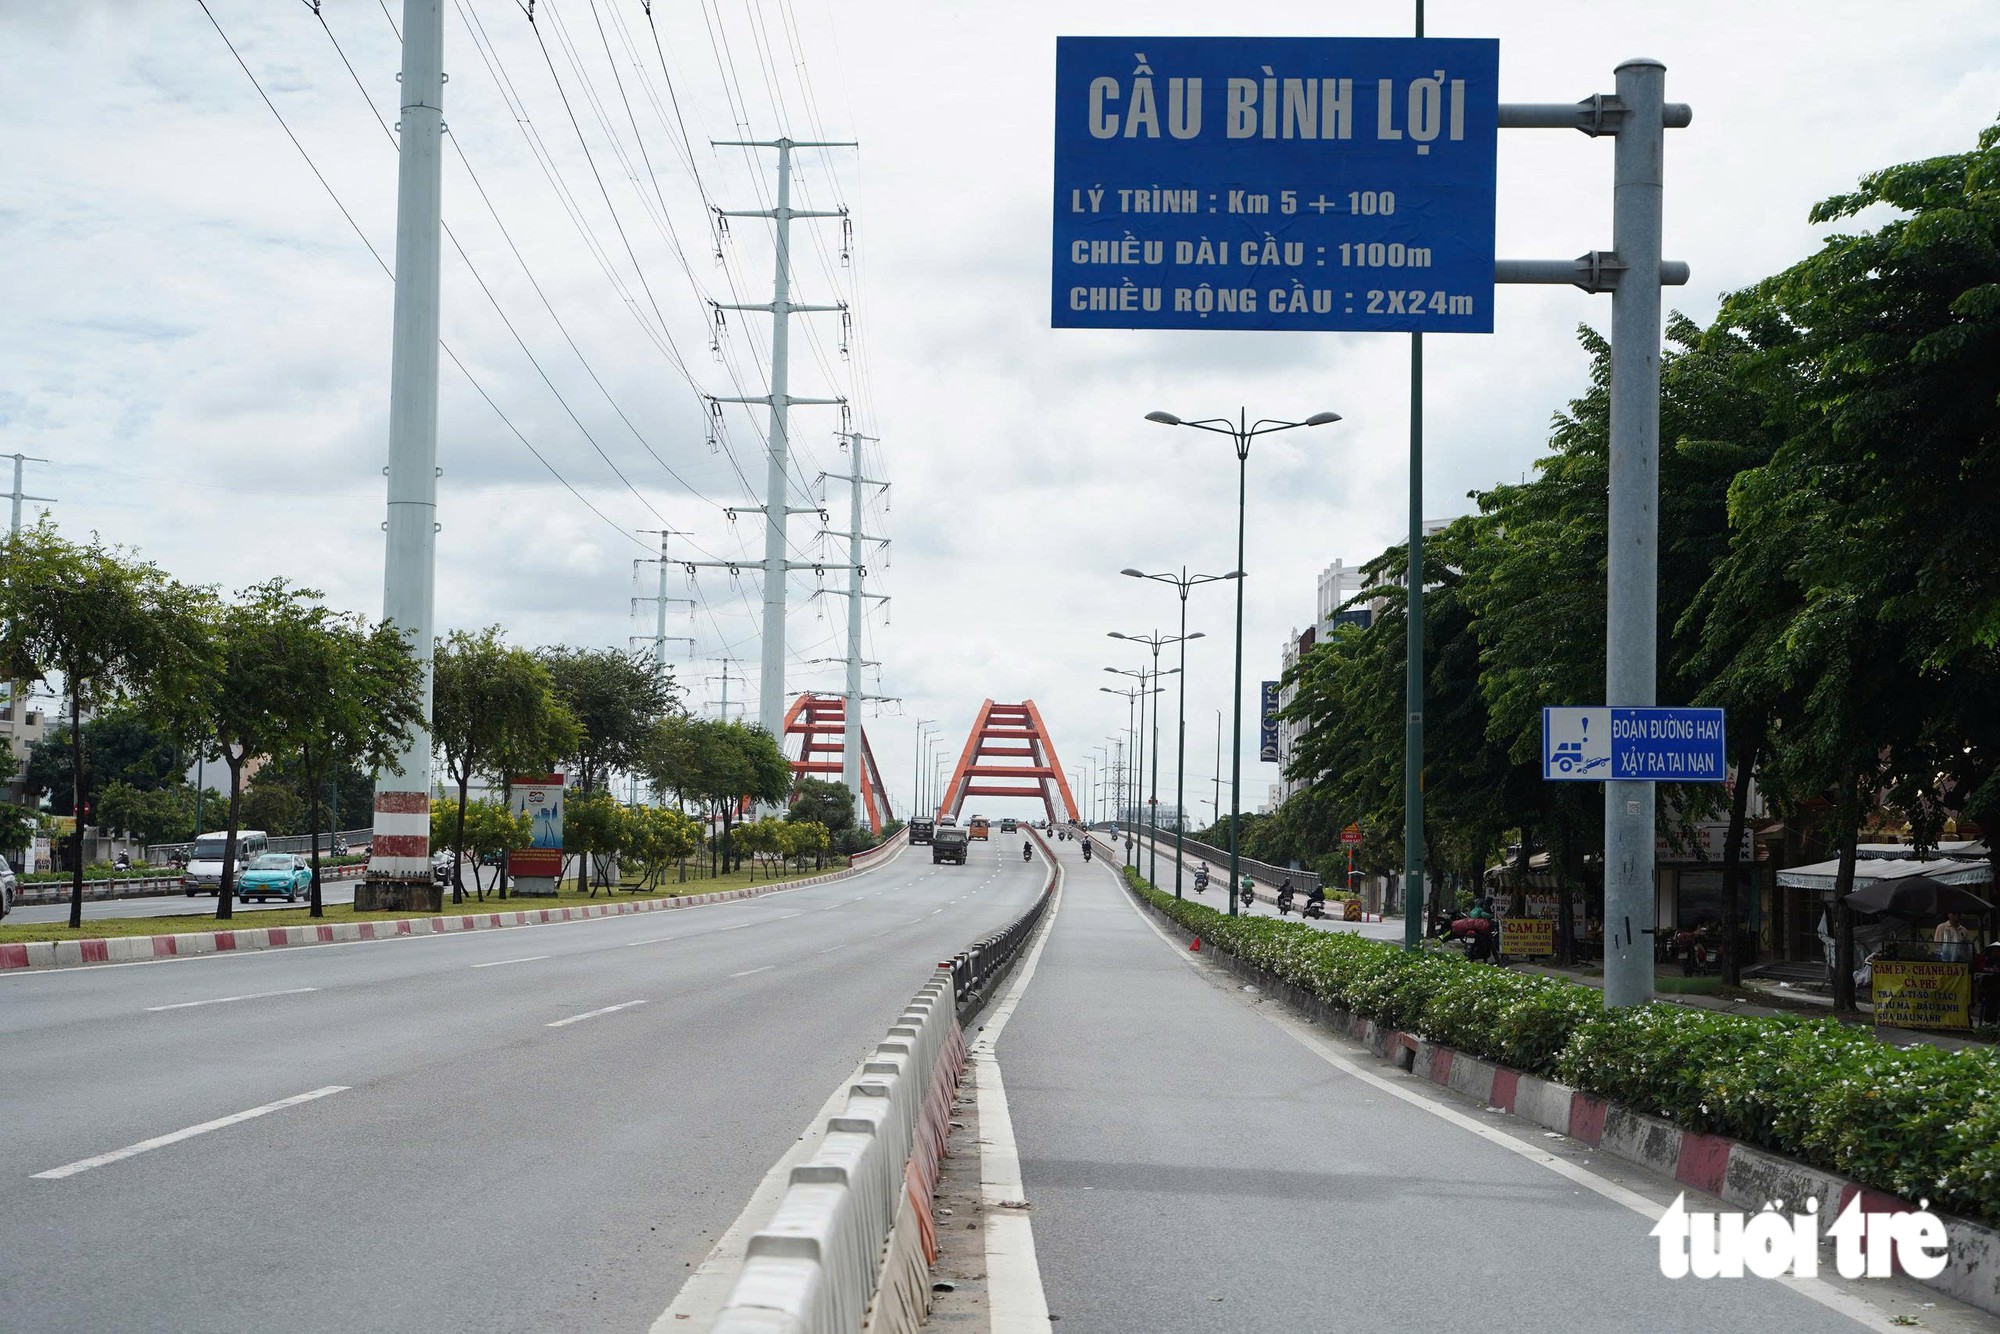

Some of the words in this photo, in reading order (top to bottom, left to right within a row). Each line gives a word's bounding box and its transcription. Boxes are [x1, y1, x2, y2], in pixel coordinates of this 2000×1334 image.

[1088, 53, 1202, 140] CẦU
[1226, 66, 1353, 140] BÌNH
[1377, 70, 1465, 155] LỢI
[1071, 184, 1105, 213] LÝ
[1117, 184, 1198, 214] TRÌNH
[1209, 193, 1217, 214] :
[1228, 190, 1270, 214] Km
[1281, 190, 1297, 215] 5
[1308, 194, 1336, 215] +
[1348, 191, 1396, 215] 100
[1071, 230, 1163, 265] CHIỀU
[1175, 236, 1229, 266] DÀI
[1240, 231, 1304, 267] CẦU
[1317, 246, 1325, 267] :
[1338, 242, 1432, 268] 1100m
[1069, 277, 1162, 312] CHIỀU
[1174, 282, 1257, 318] RỘNG
[1268, 279, 1332, 314] CẦU
[1345, 293, 1353, 314] :
[1366, 290, 1474, 316] 2X24m
[1612, 719, 1648, 741] ĐOẠN
[1650, 714, 1694, 740] ĐƯỜNG
[1696, 720, 1721, 740] HAY
[1621, 746, 1645, 772] XẢY
[1648, 752, 1665, 772] RA
[1666, 752, 1685, 772] TAI
[1687, 752, 1714, 774] NẠN
[1508, 923, 1533, 934] CAM
[1537, 920, 1551, 934] ÉP
[1874, 964, 1892, 974] CAM
[1912, 964, 1945, 976] CHANH
